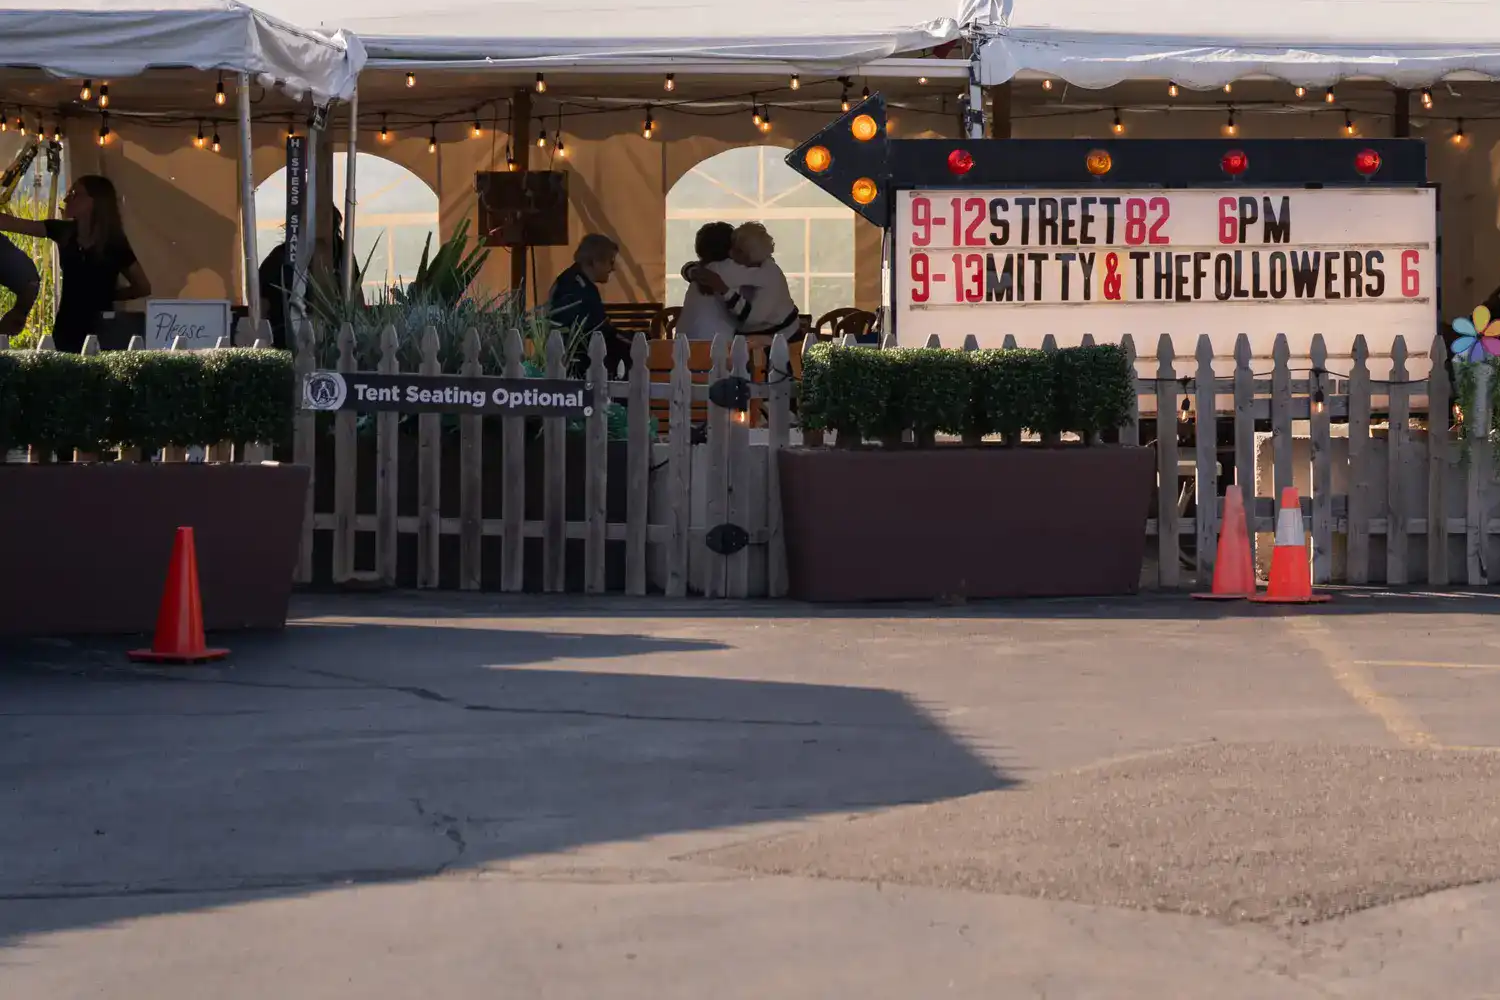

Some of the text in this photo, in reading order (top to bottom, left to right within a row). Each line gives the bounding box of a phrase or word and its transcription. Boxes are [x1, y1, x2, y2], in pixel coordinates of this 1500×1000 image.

[290, 138, 300, 206] HSTESS
[911, 196, 986, 247] 9-12
[1218, 195, 1291, 245] 6PM
[911, 252, 984, 303] 9-13
[986, 251, 1096, 302] MITTY
[1103, 251, 1122, 301] &
[1400, 249, 1420, 298] 6
[153, 312, 211, 342] Please
[353, 383, 400, 402] Tent
[405, 385, 486, 408] Seating
[492, 388, 584, 408] Optional
